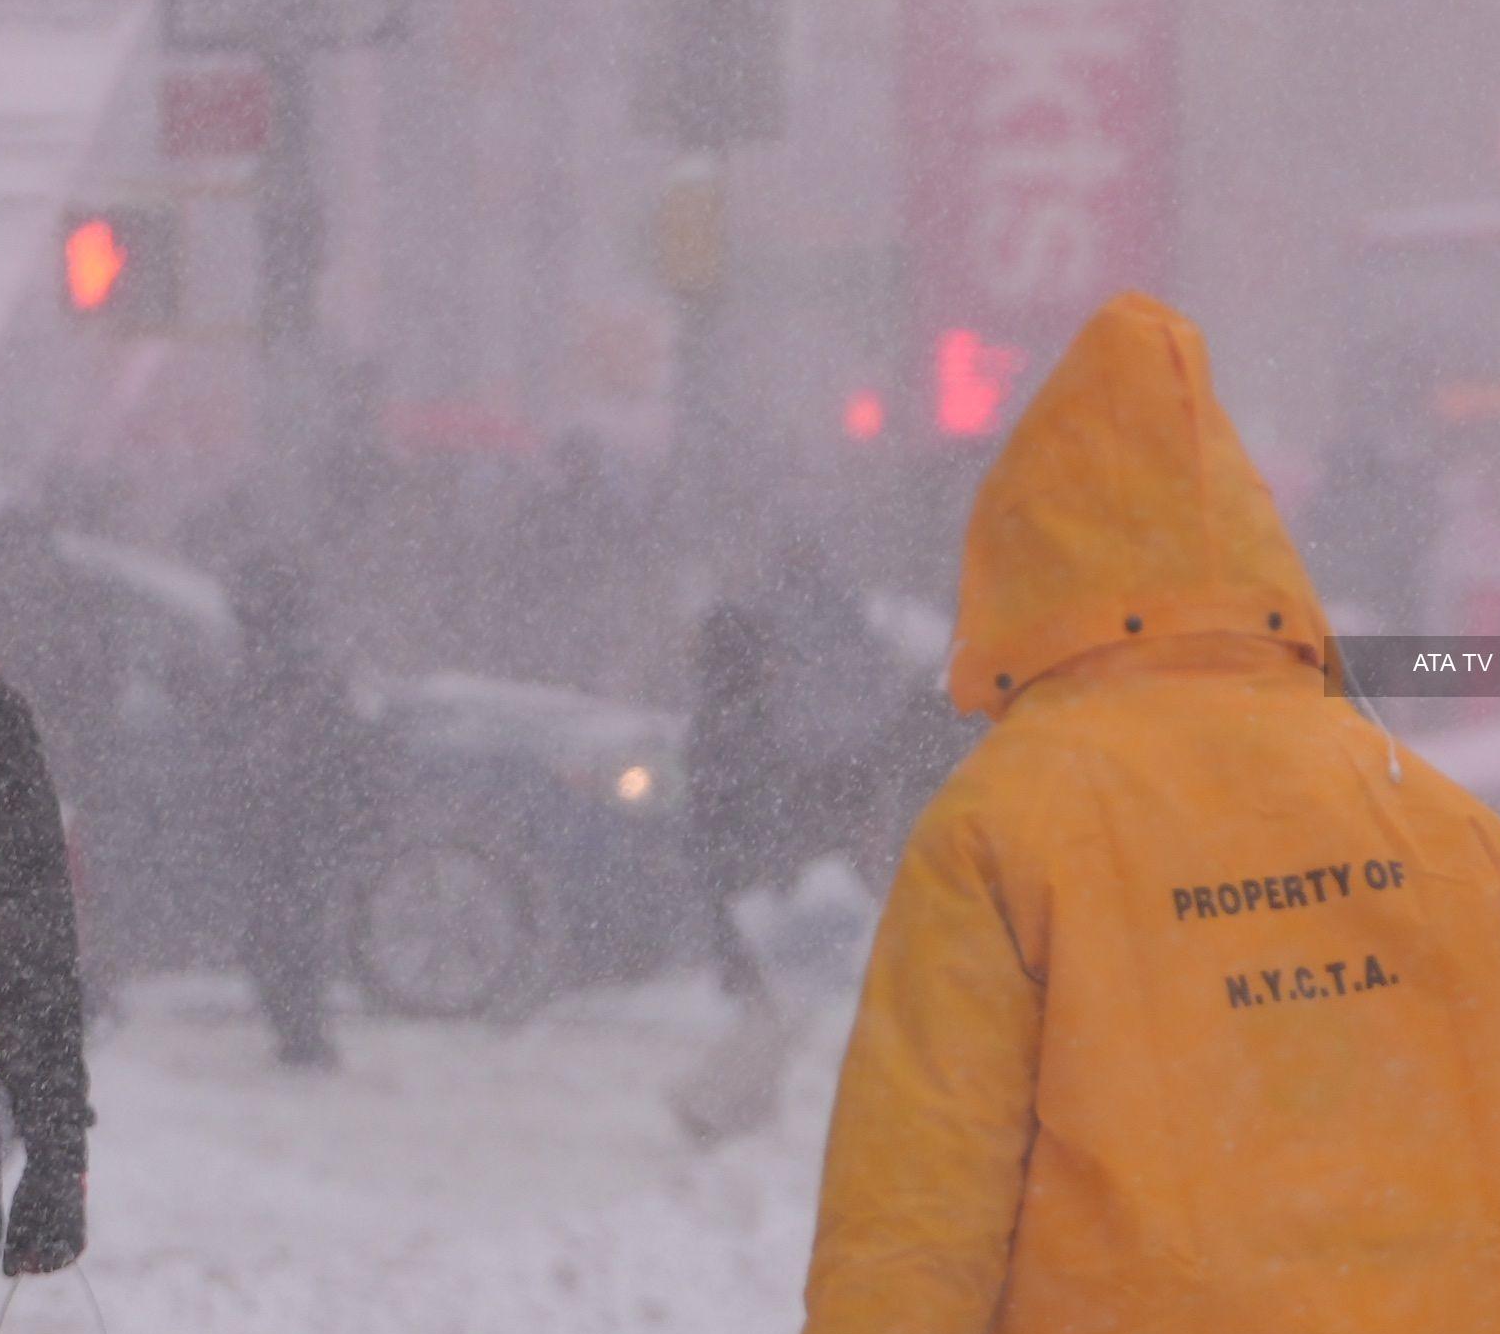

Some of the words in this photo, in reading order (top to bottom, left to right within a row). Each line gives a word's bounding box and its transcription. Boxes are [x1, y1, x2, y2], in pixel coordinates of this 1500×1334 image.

[1172, 862, 1351, 921] PROPERTY
[1364, 860, 1404, 890] OF
[1225, 955, 1399, 1009] N.Y.C.T.A.
